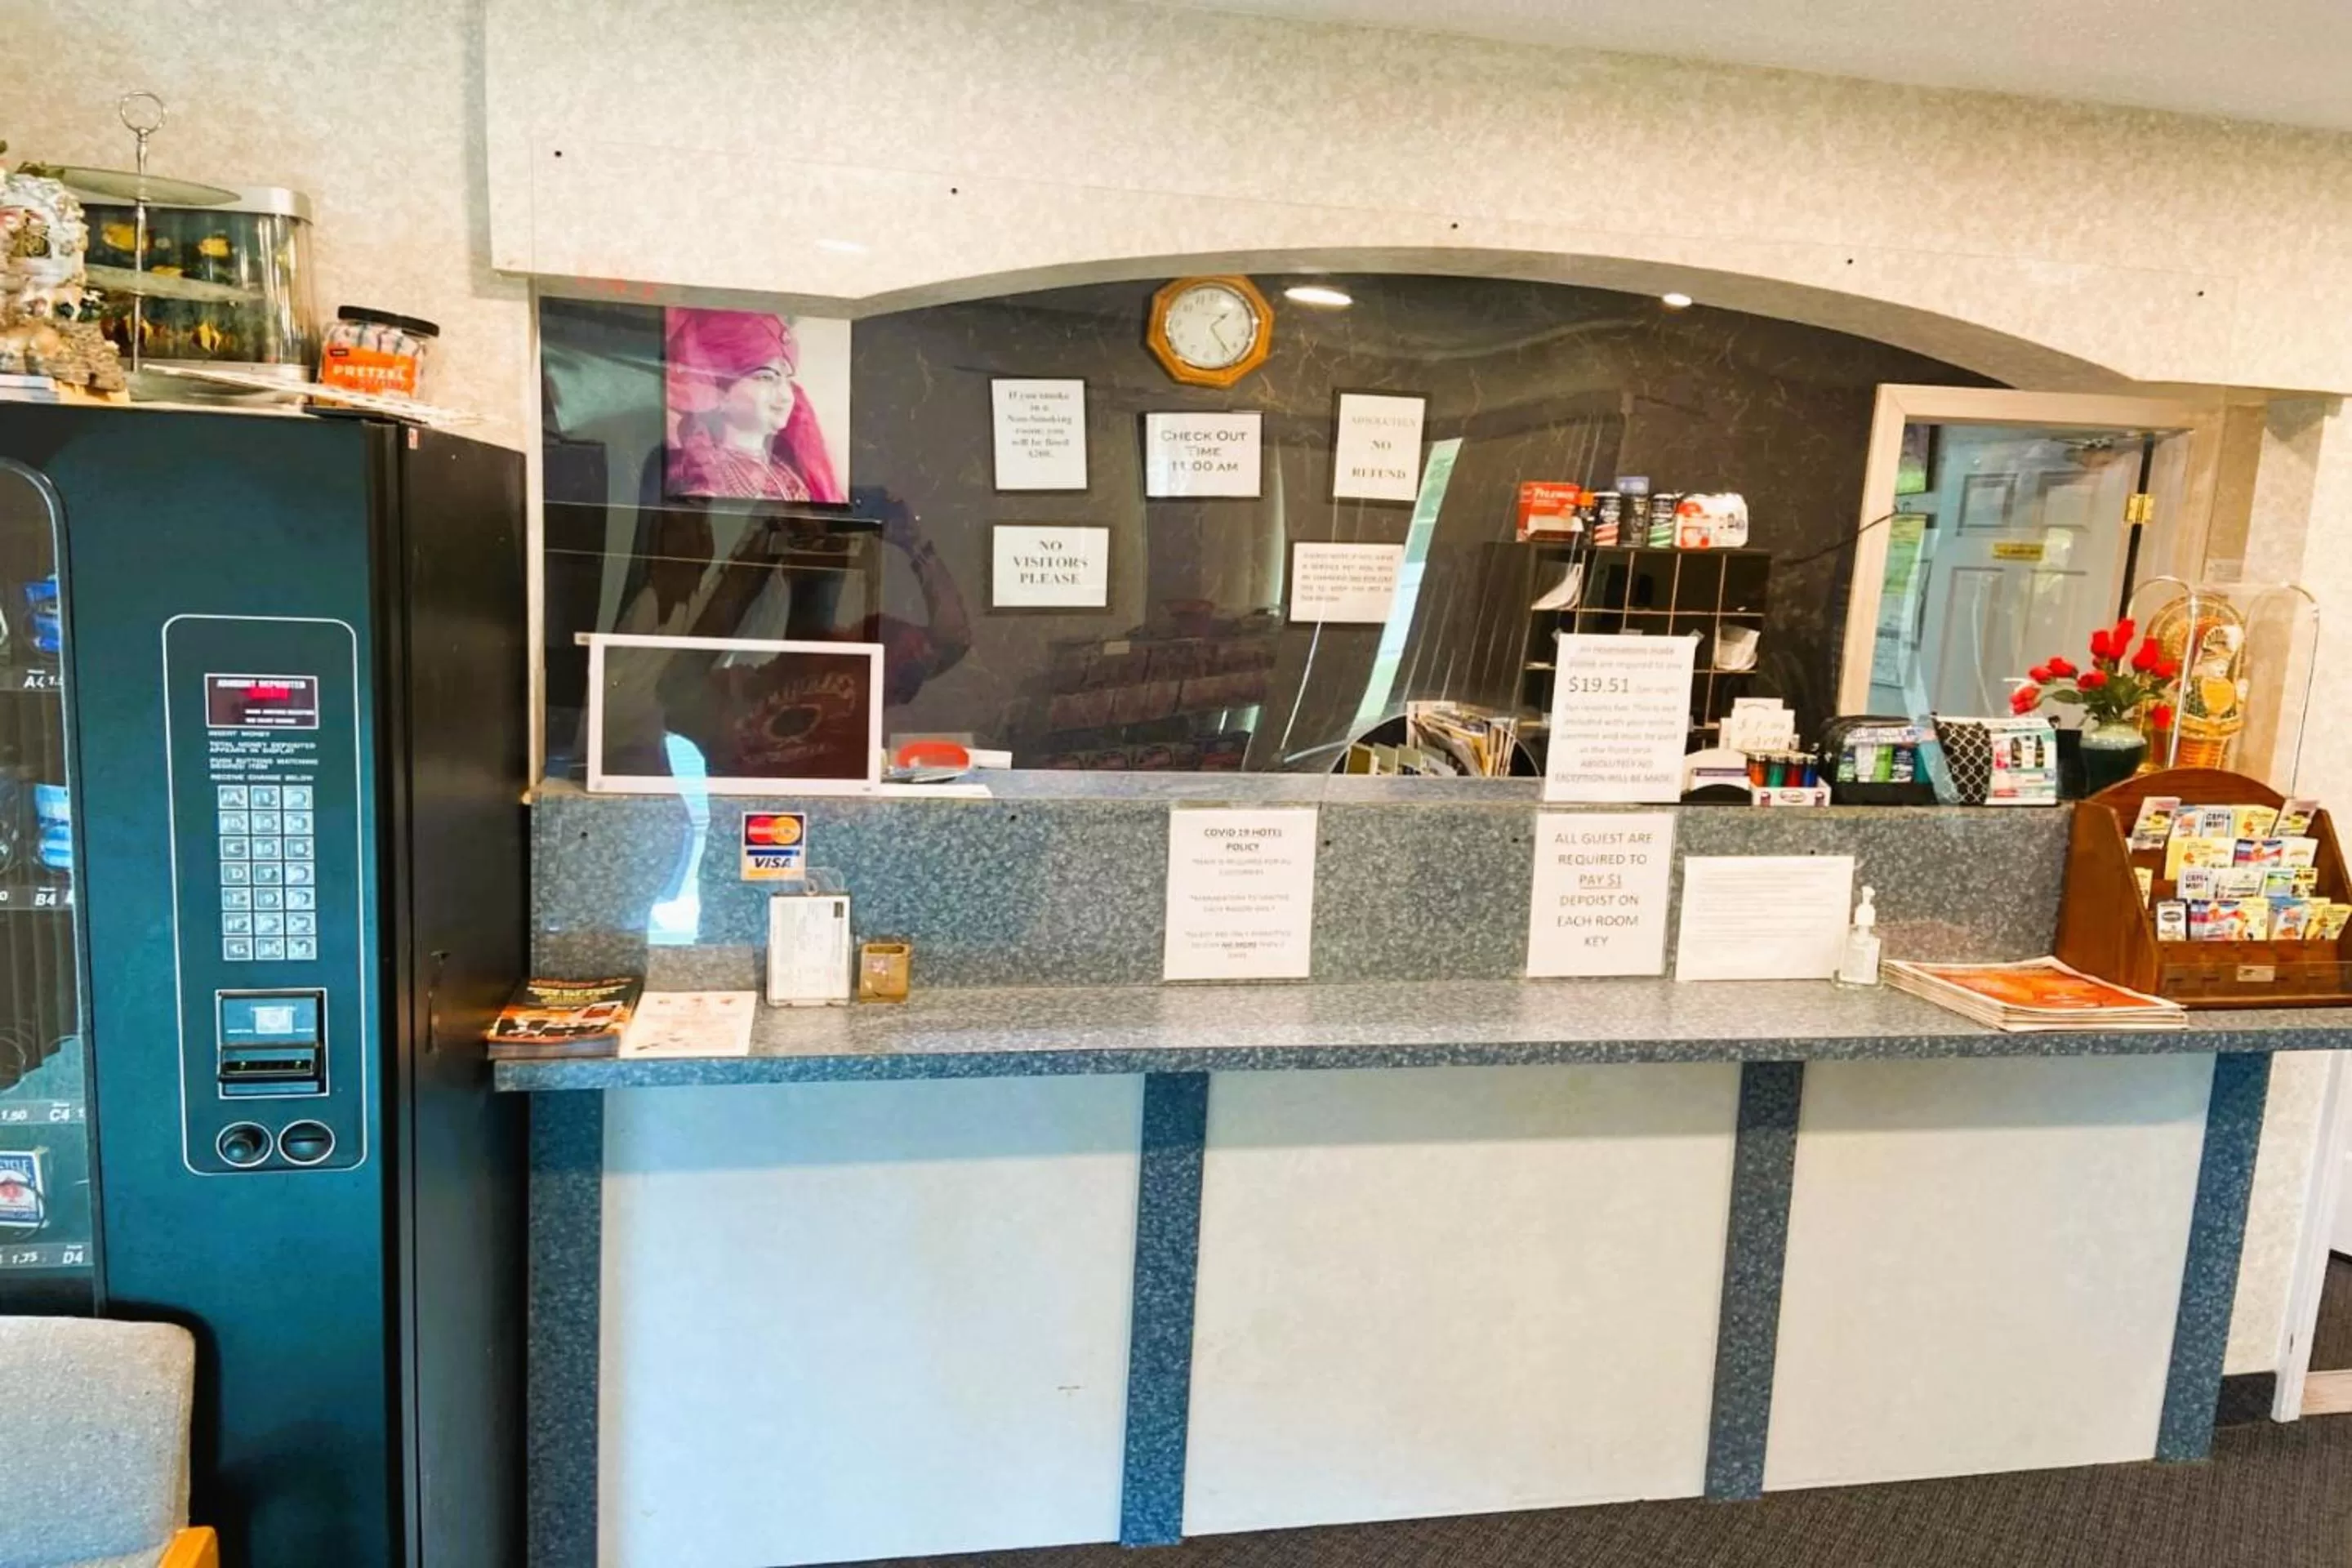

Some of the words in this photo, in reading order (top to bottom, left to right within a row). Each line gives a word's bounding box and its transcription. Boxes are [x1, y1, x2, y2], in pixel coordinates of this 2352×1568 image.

[1160, 430, 1212, 442] CHECK
[1216, 430, 1248, 442] OUT
[1185, 445, 1223, 457] TIME
[1370, 439, 1392, 451] NO
[1172, 460, 1213, 471] 1100
[1216, 462, 1239, 471] AM
[1352, 466, 1406, 479] REFUND
[1039, 540, 1062, 551] NO
[1013, 555, 1089, 568] VISITORS
[1020, 572, 1080, 586] PLEASE
[1568, 675, 1630, 694] $19.51
[1204, 827, 1236, 838] COVID
[1238, 827, 1250, 838] 19
[1252, 827, 1282, 838] HOTEL
[1555, 832, 1576, 844] ALL
[1581, 832, 1624, 845] GUEST
[1628, 832, 1654, 844] ARE
[1226, 842, 1259, 852] POLICY
[755, 857, 791, 869] VISA
[1558, 854, 1625, 866] REQUIRED
[1630, 854, 1648, 866] TO
[1579, 873, 1604, 885] PAY
[1607, 872, 1622, 887] $1
[35, 893, 56, 906] B4
[1560, 895, 1615, 906] DEPOIST
[1619, 895, 1639, 906] ON
[1557, 915, 1592, 928] EACH
[1596, 915, 1639, 927] ROOM
[1584, 936, 1609, 947] KEY
[50, 1108, 70, 1121] C4
[63, 1251, 83, 1264] D4
